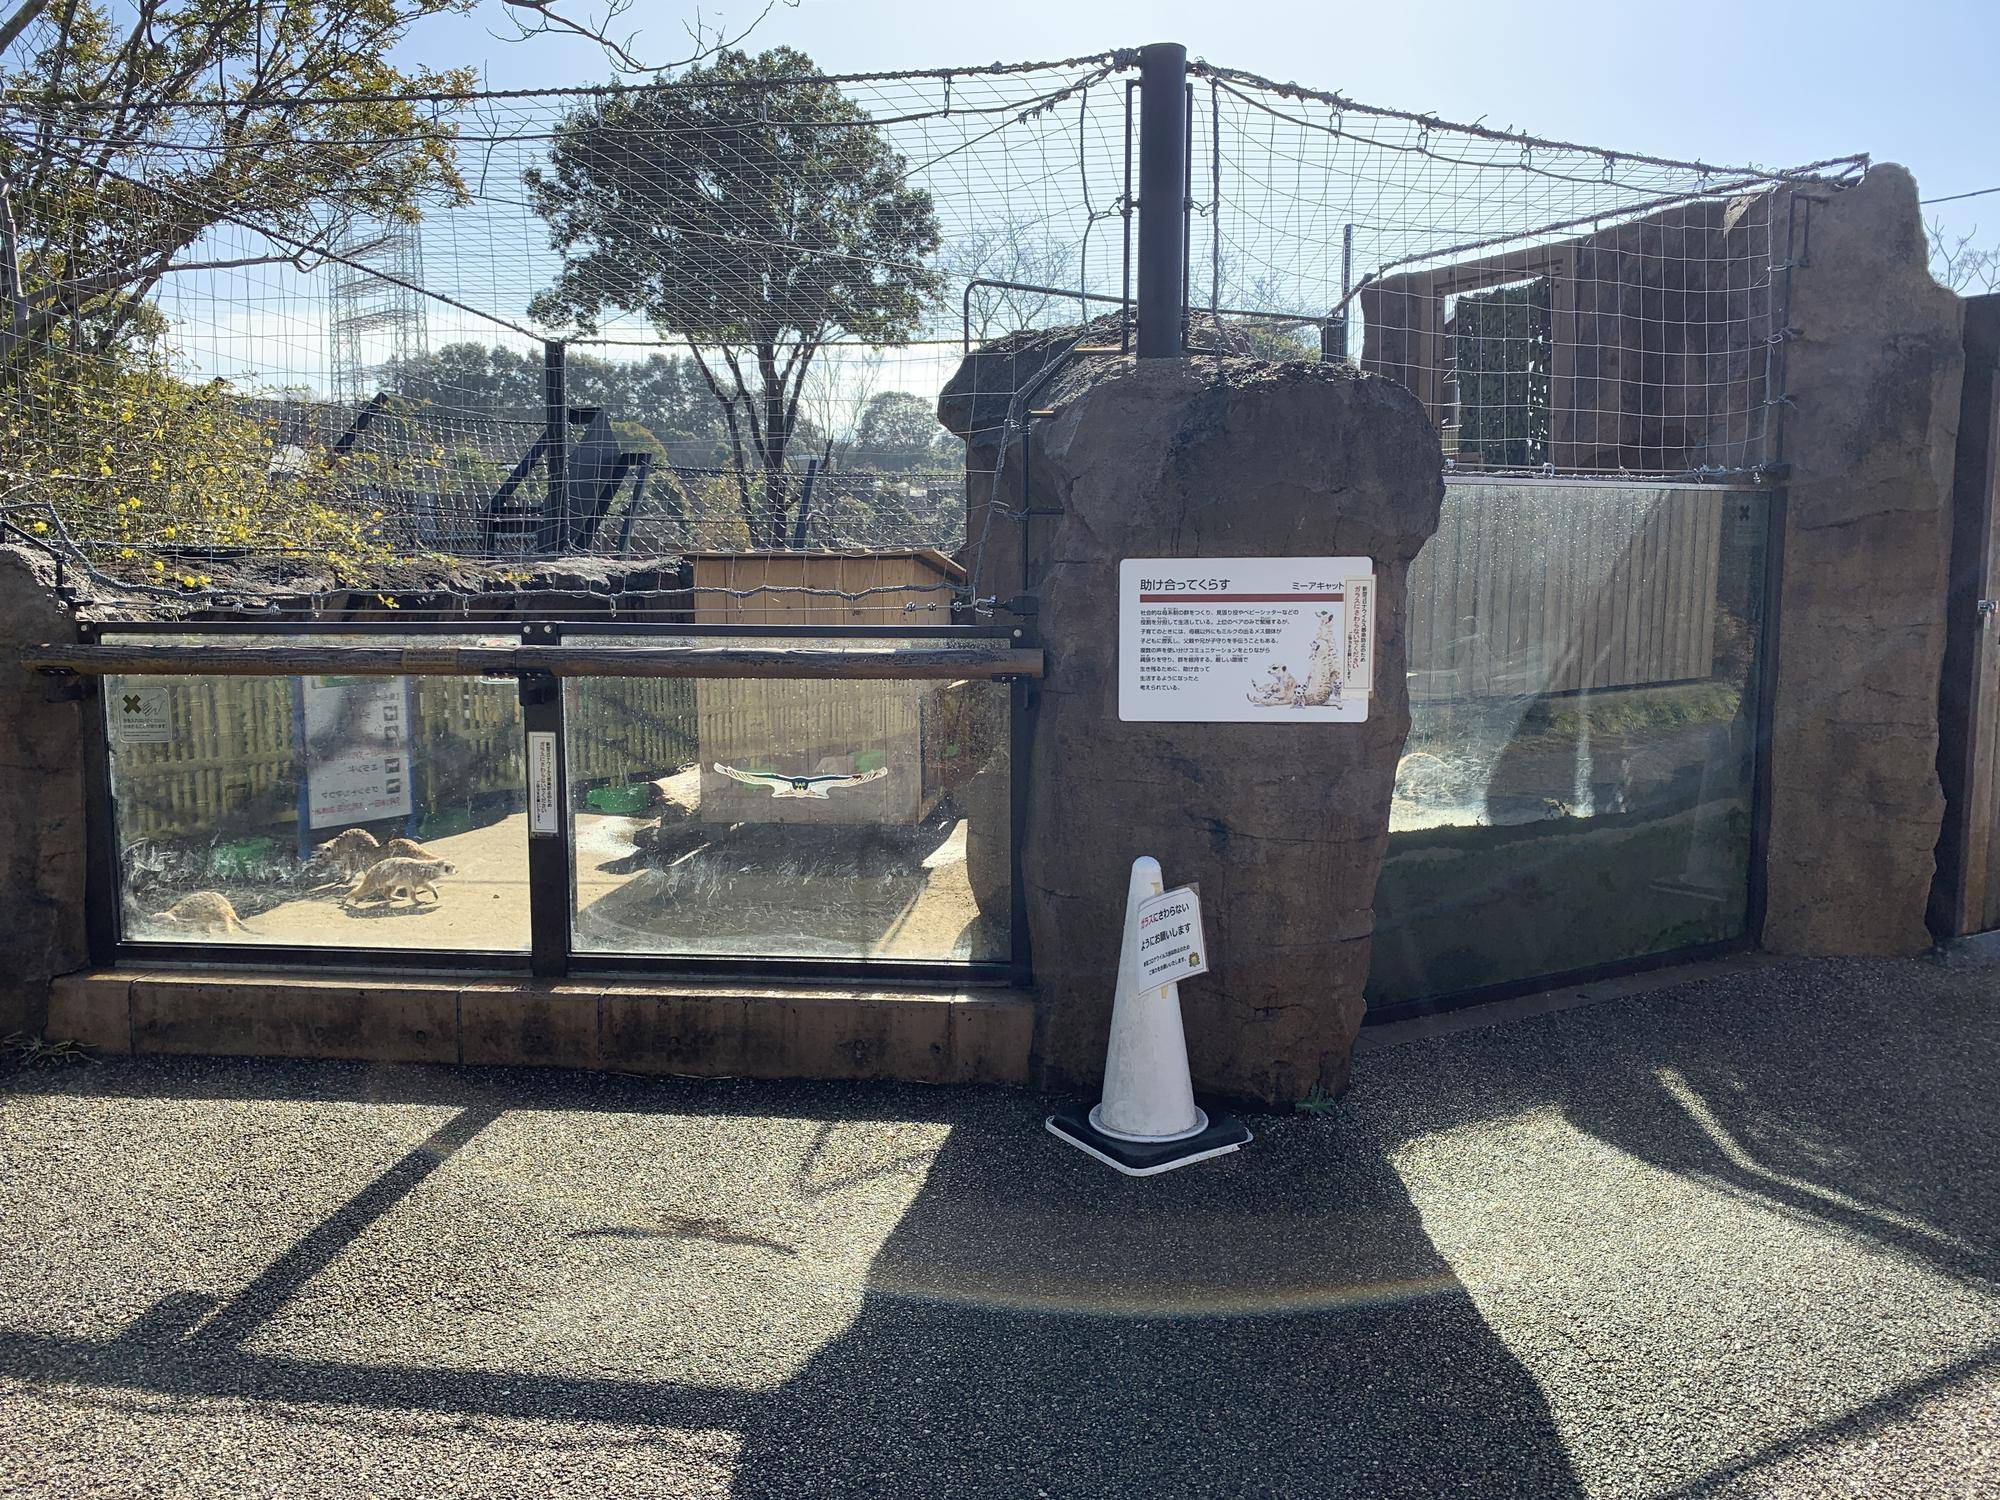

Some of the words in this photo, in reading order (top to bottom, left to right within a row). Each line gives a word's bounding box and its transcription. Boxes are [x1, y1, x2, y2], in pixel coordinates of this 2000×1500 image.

[1139, 578, 1230, 592] 助け合ってくらす
[1292, 581, 1345, 591] ミーアキャット
[1140, 903, 1190, 930] ガラスにさわらない
[1141, 922, 1191, 951] ようにお願いします
